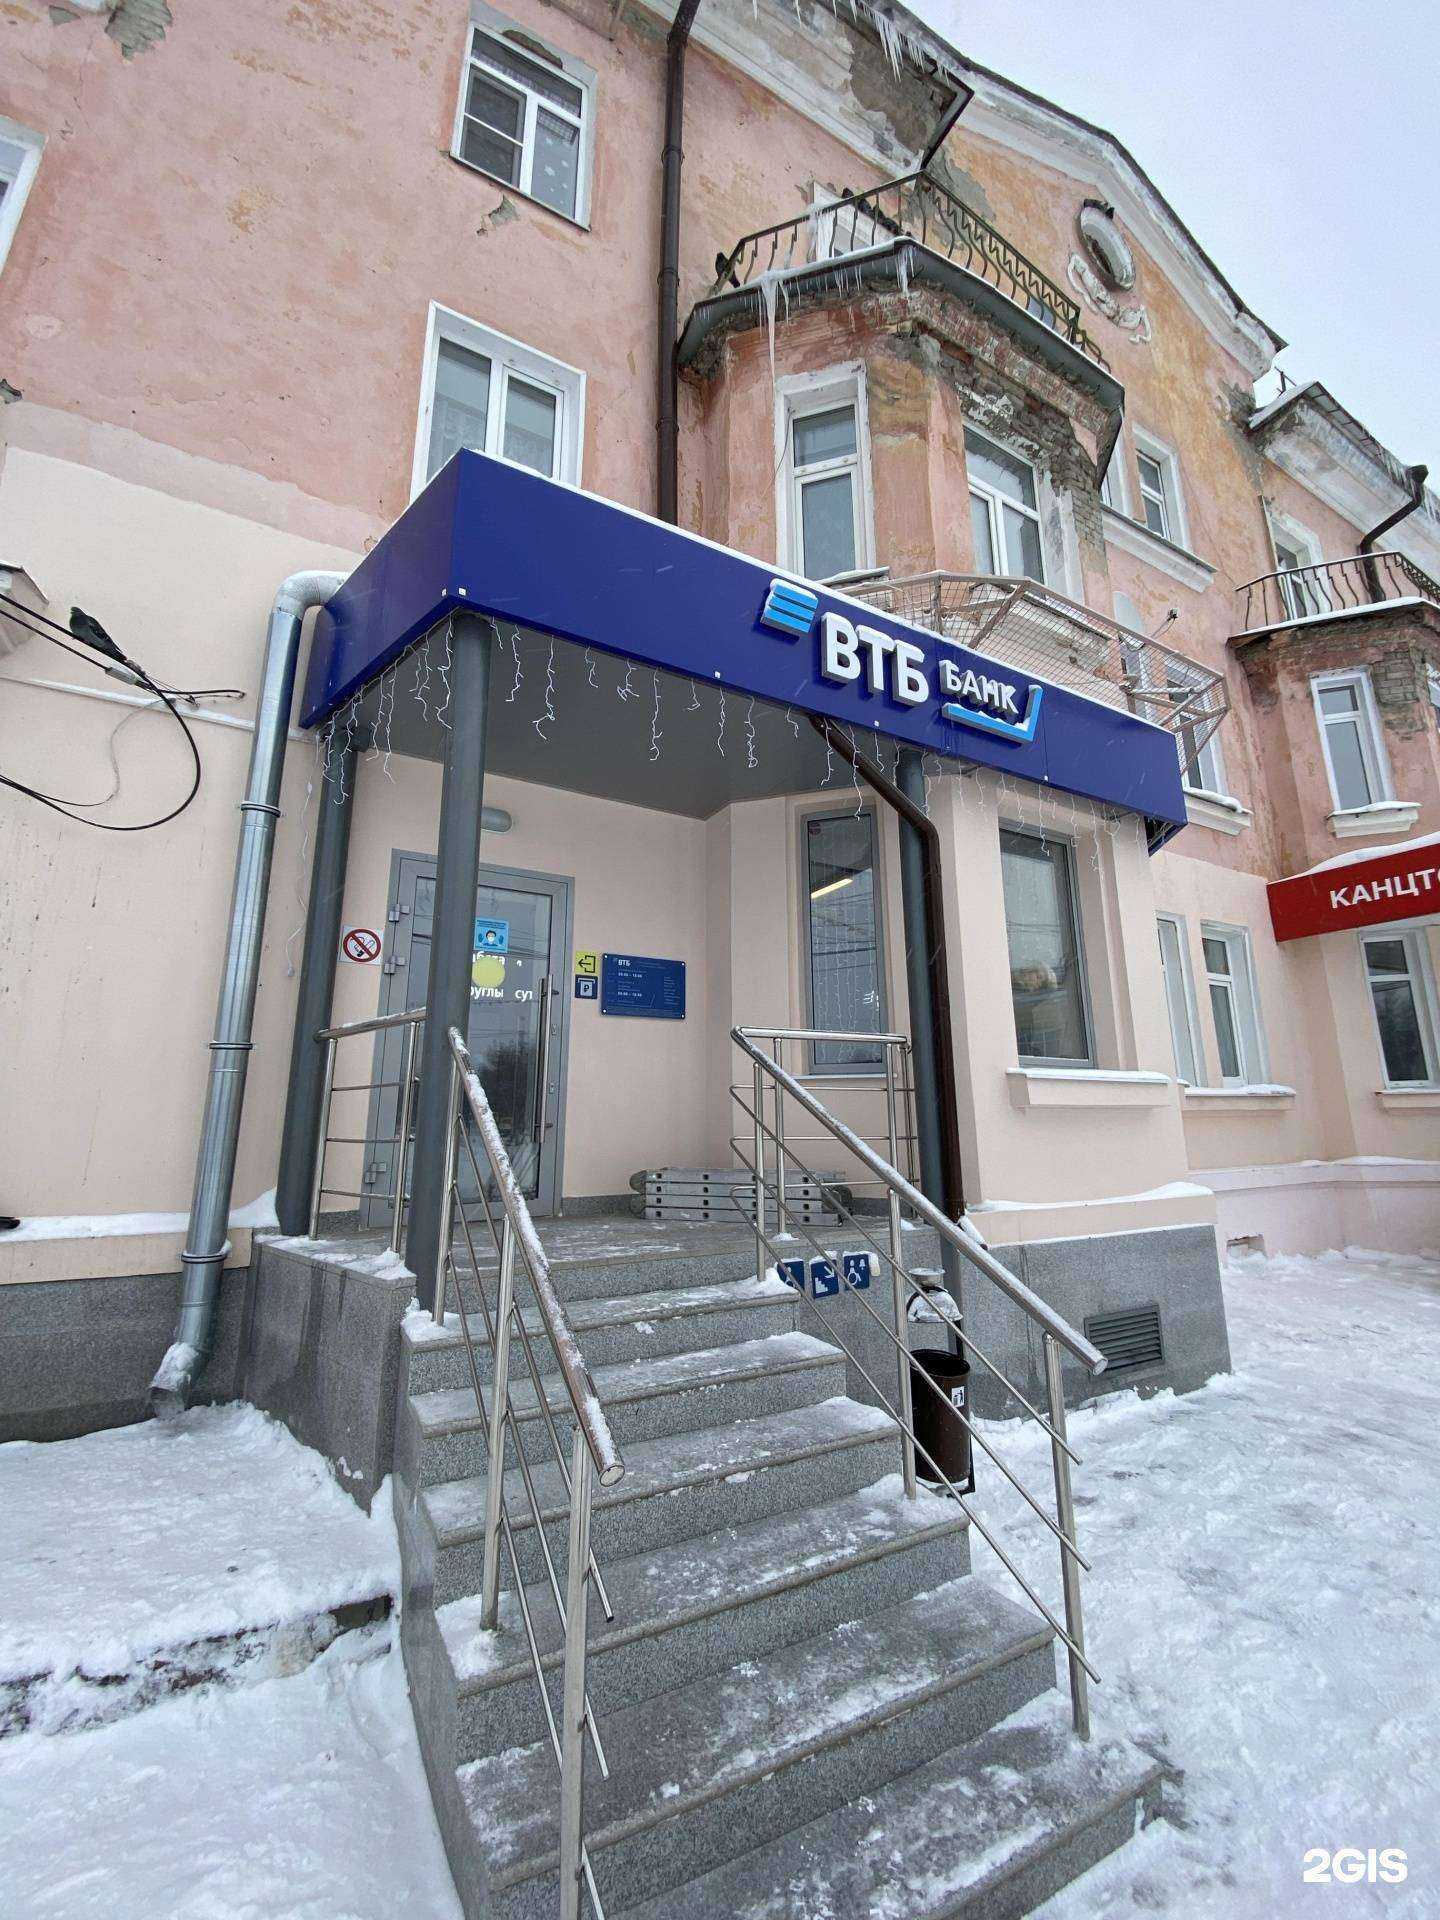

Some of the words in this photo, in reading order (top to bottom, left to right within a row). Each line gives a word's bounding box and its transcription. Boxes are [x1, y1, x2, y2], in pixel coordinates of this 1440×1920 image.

[821, 611, 929, 706] ВТБ
[939, 659, 1019, 714] БАНК
[1329, 867, 1440, 909] КАНЦТ
